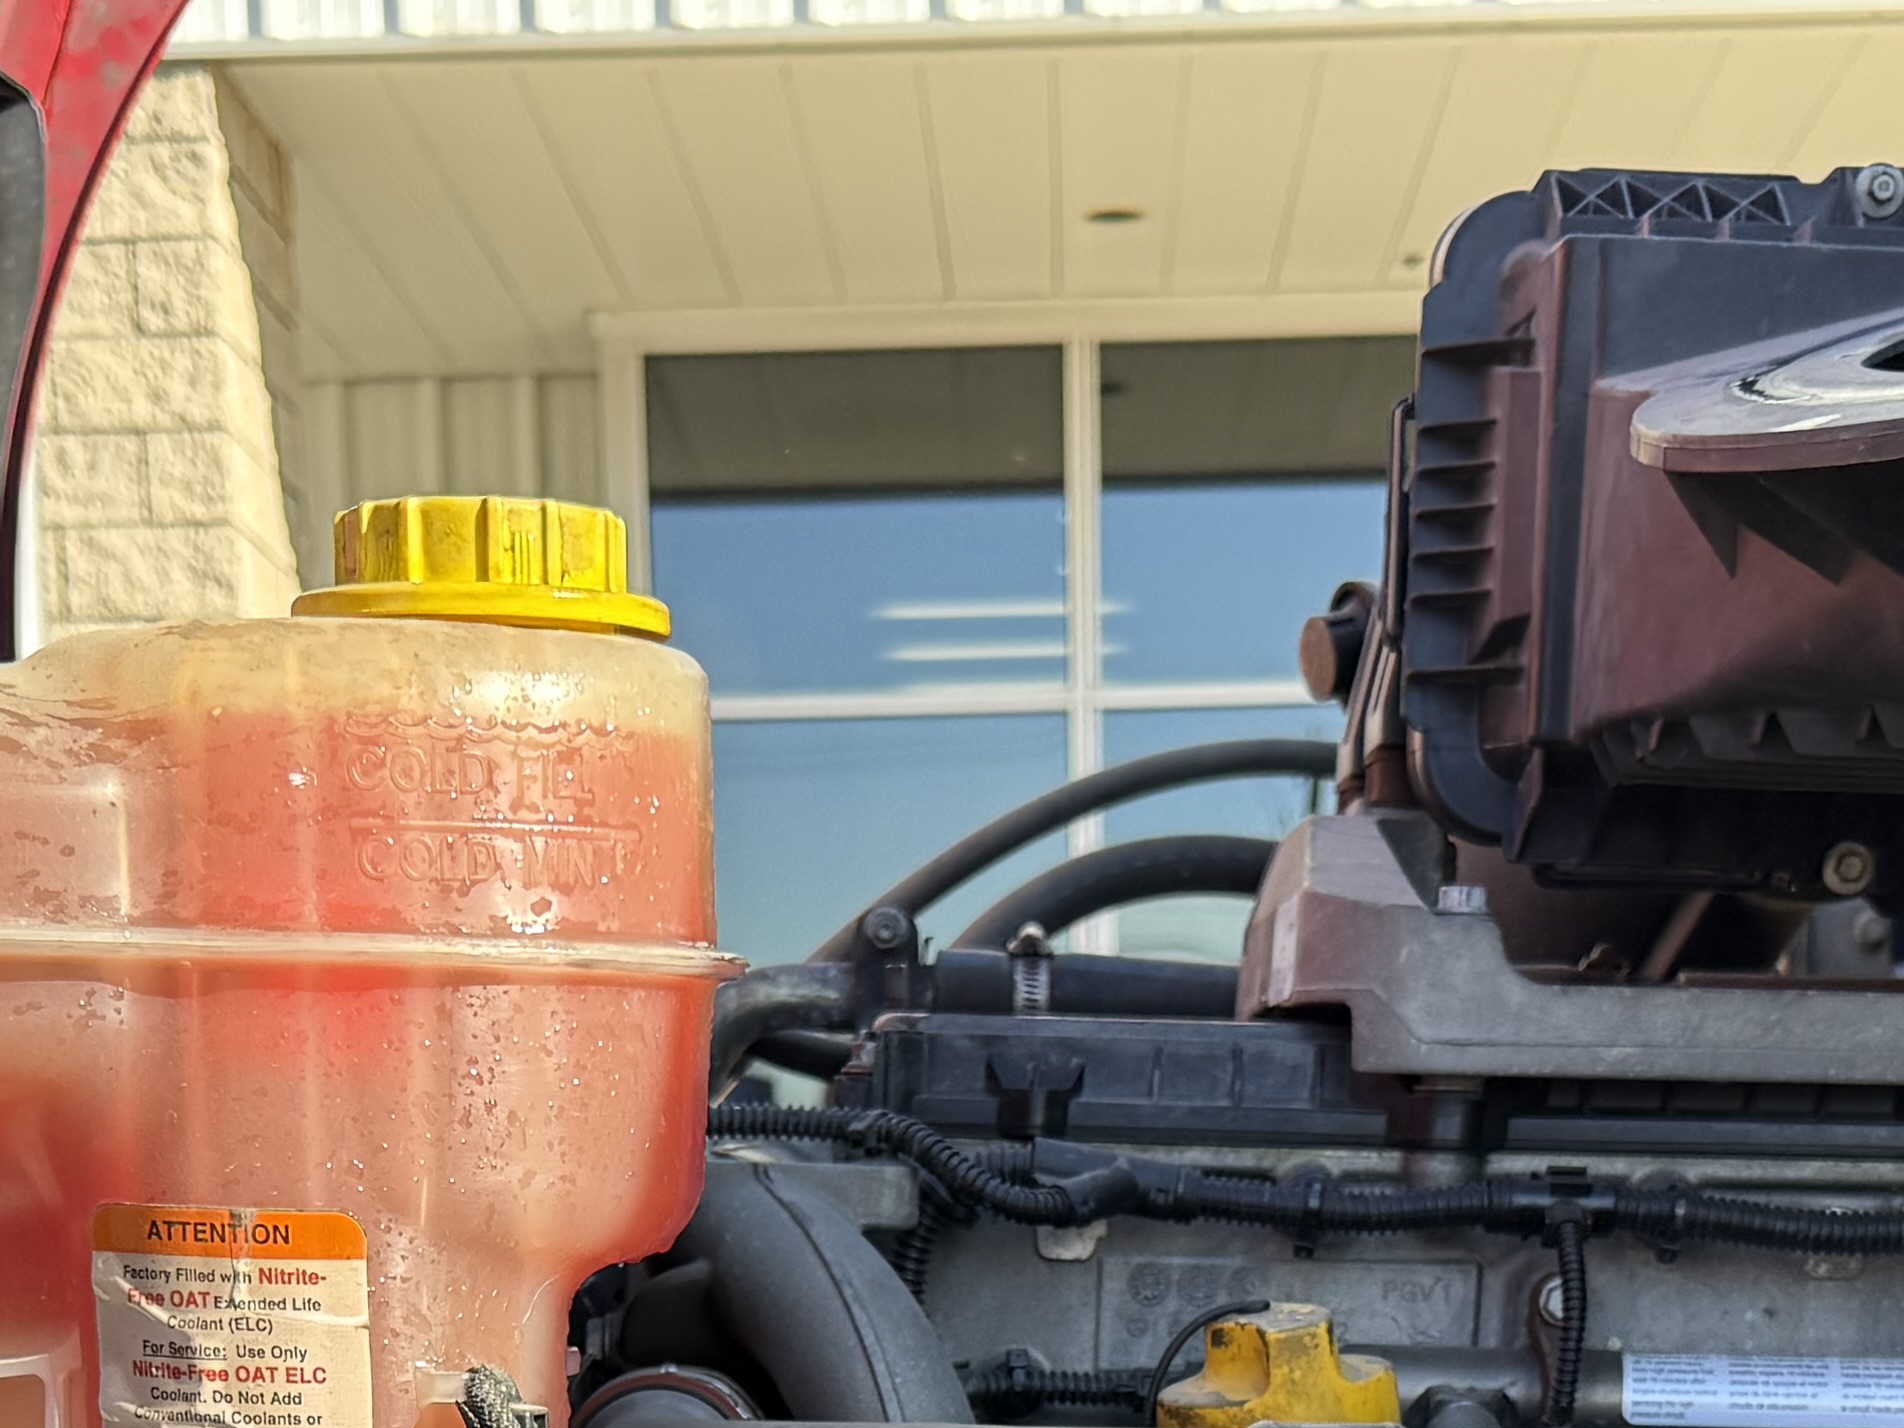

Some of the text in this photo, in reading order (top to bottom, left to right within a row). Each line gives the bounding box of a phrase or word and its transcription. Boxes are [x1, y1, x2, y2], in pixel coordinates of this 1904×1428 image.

[346, 746, 498, 799] COLD
[356, 834, 498, 884] COLD
[147, 1220, 290, 1245] ATTENTION
[123, 1265, 171, 1284] Factory
[176, 1268, 216, 1283] Filled
[258, 1268, 327, 1285] Nitrite-
[127, 1288, 321, 1312] Free OAT Extended Life
[167, 1315, 273, 1335] Coolant (ELC)
[143, 1340, 308, 1363] For Service: Use Only
[133, 1360, 327, 1384] Nitrite-Free OAT ELC
[151, 1387, 302, 1406] Coolant. Do Not Add
[231, 1411, 301, 1426] Coolants
[307, 1414, 323, 1426] or
